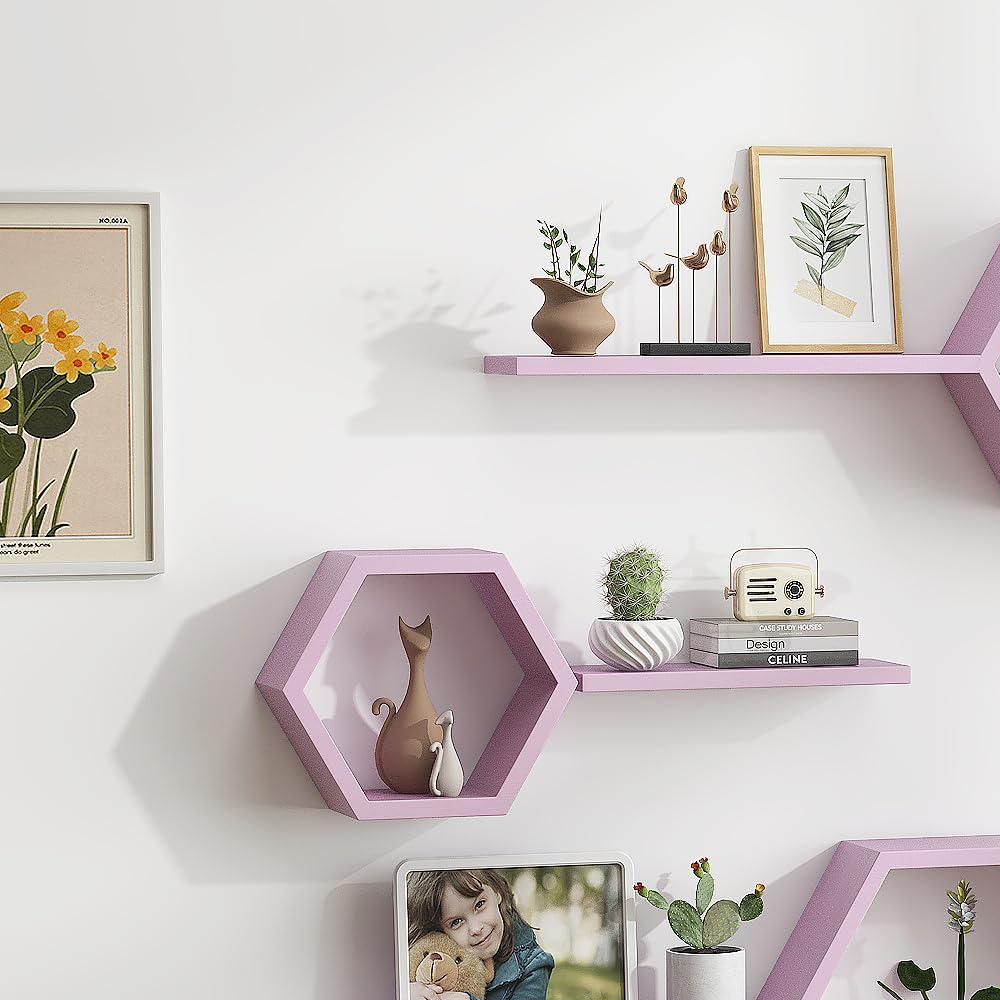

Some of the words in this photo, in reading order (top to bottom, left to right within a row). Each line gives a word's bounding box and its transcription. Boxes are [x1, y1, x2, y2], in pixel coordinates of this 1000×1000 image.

[759, 624, 776, 632] CASE
[746, 639, 785, 651] Design
[767, 654, 808, 665] CELINE
